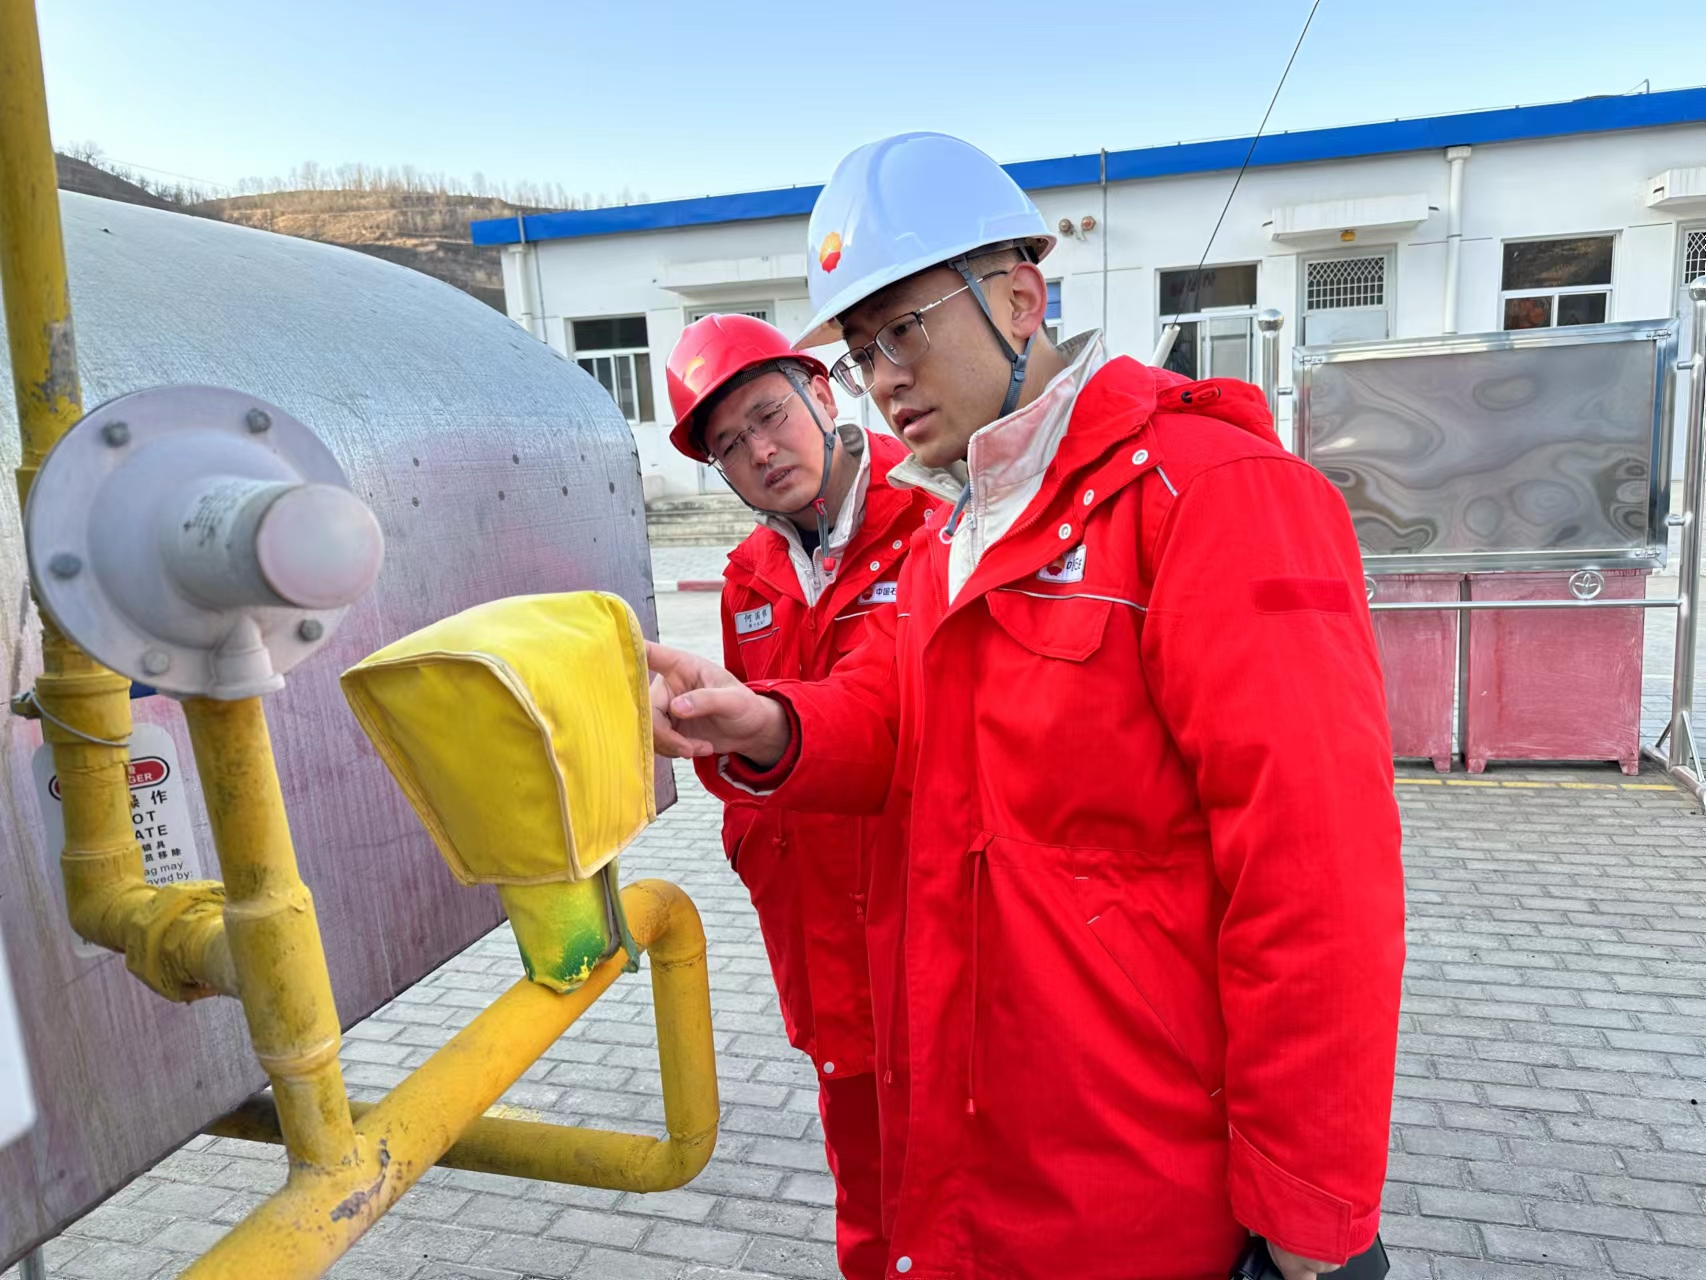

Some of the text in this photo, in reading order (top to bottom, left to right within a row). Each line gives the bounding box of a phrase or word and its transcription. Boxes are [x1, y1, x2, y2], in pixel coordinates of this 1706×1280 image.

[128, 772, 153, 784] GER
[132, 810, 156, 825] OT
[160, 861, 184, 873] may
